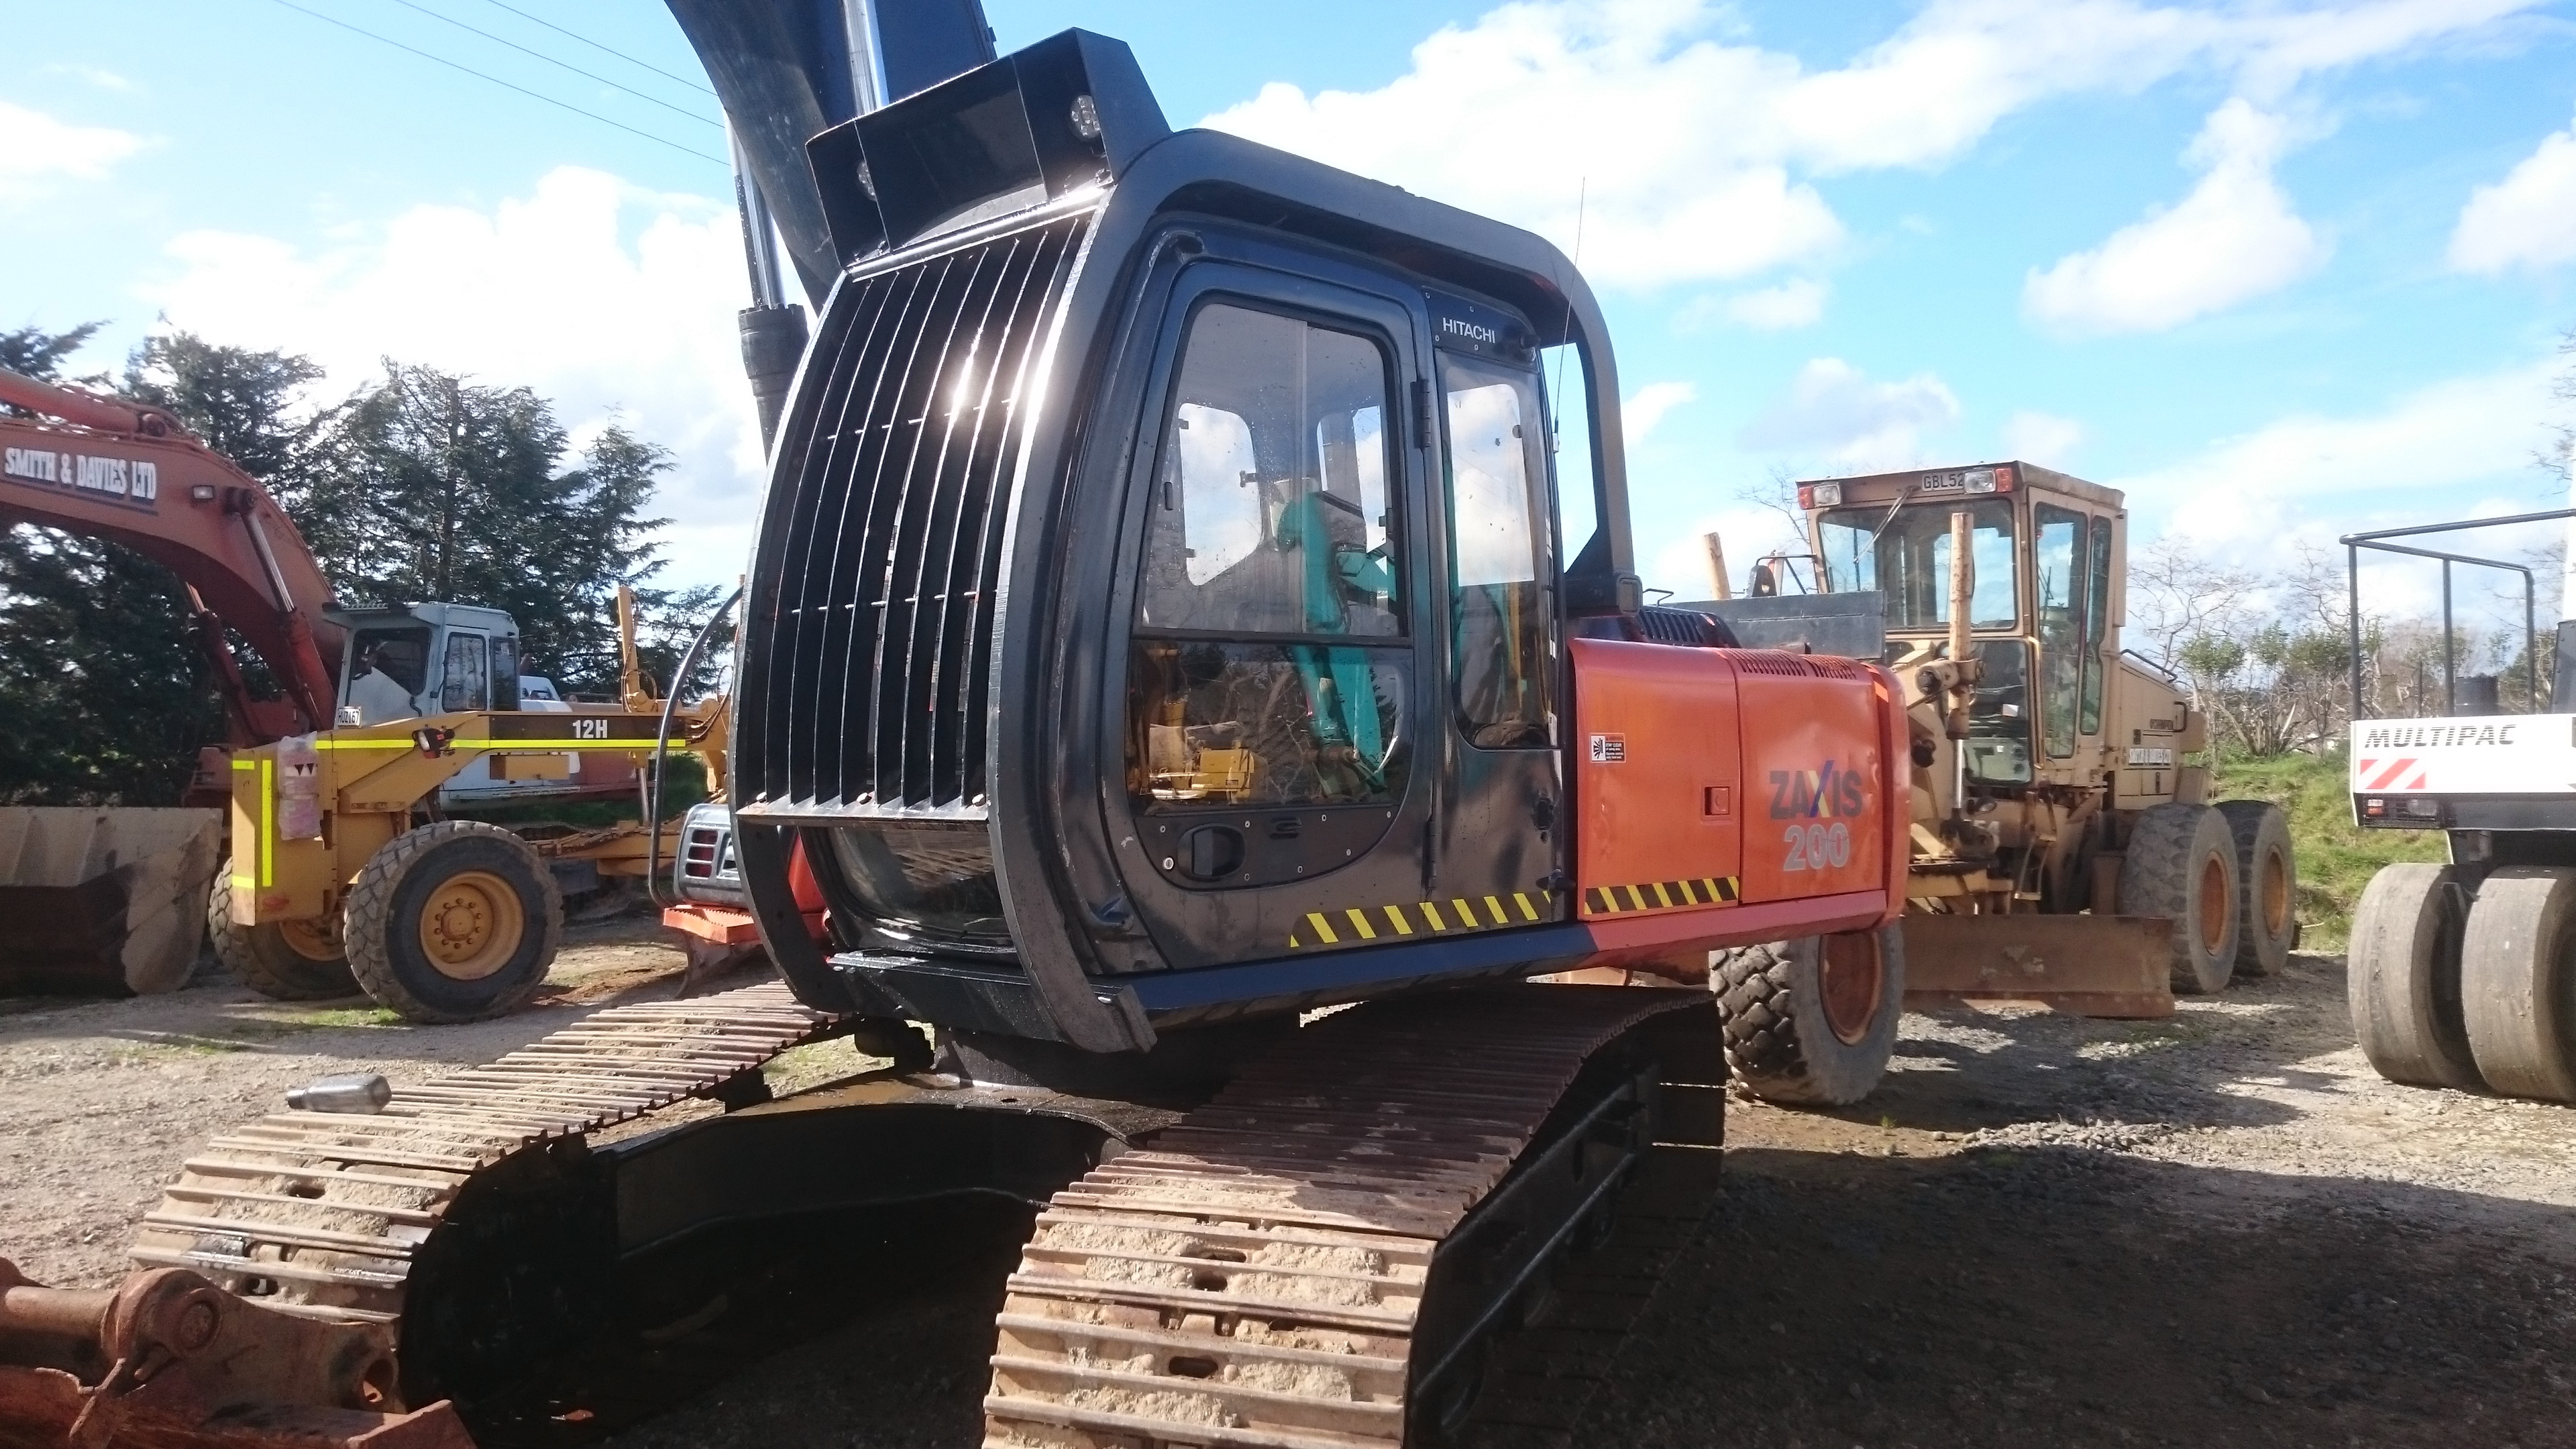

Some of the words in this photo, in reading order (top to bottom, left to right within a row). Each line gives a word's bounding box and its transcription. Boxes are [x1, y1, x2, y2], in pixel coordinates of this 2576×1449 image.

[1443, 317, 1495, 343] HITACHI
[5, 447, 56, 482] SMITH
[60, 453, 72, 484] &
[76, 455, 127, 494] DAVIES
[131, 461, 156, 499] LTD
[338, 711, 360, 723] HUZ167
[572, 719, 608, 739] 12H
[2364, 724, 2517, 748] MULTIPAC
[1770, 760, 1863, 819] ZAXIS
[1783, 822, 1850, 871] 200
